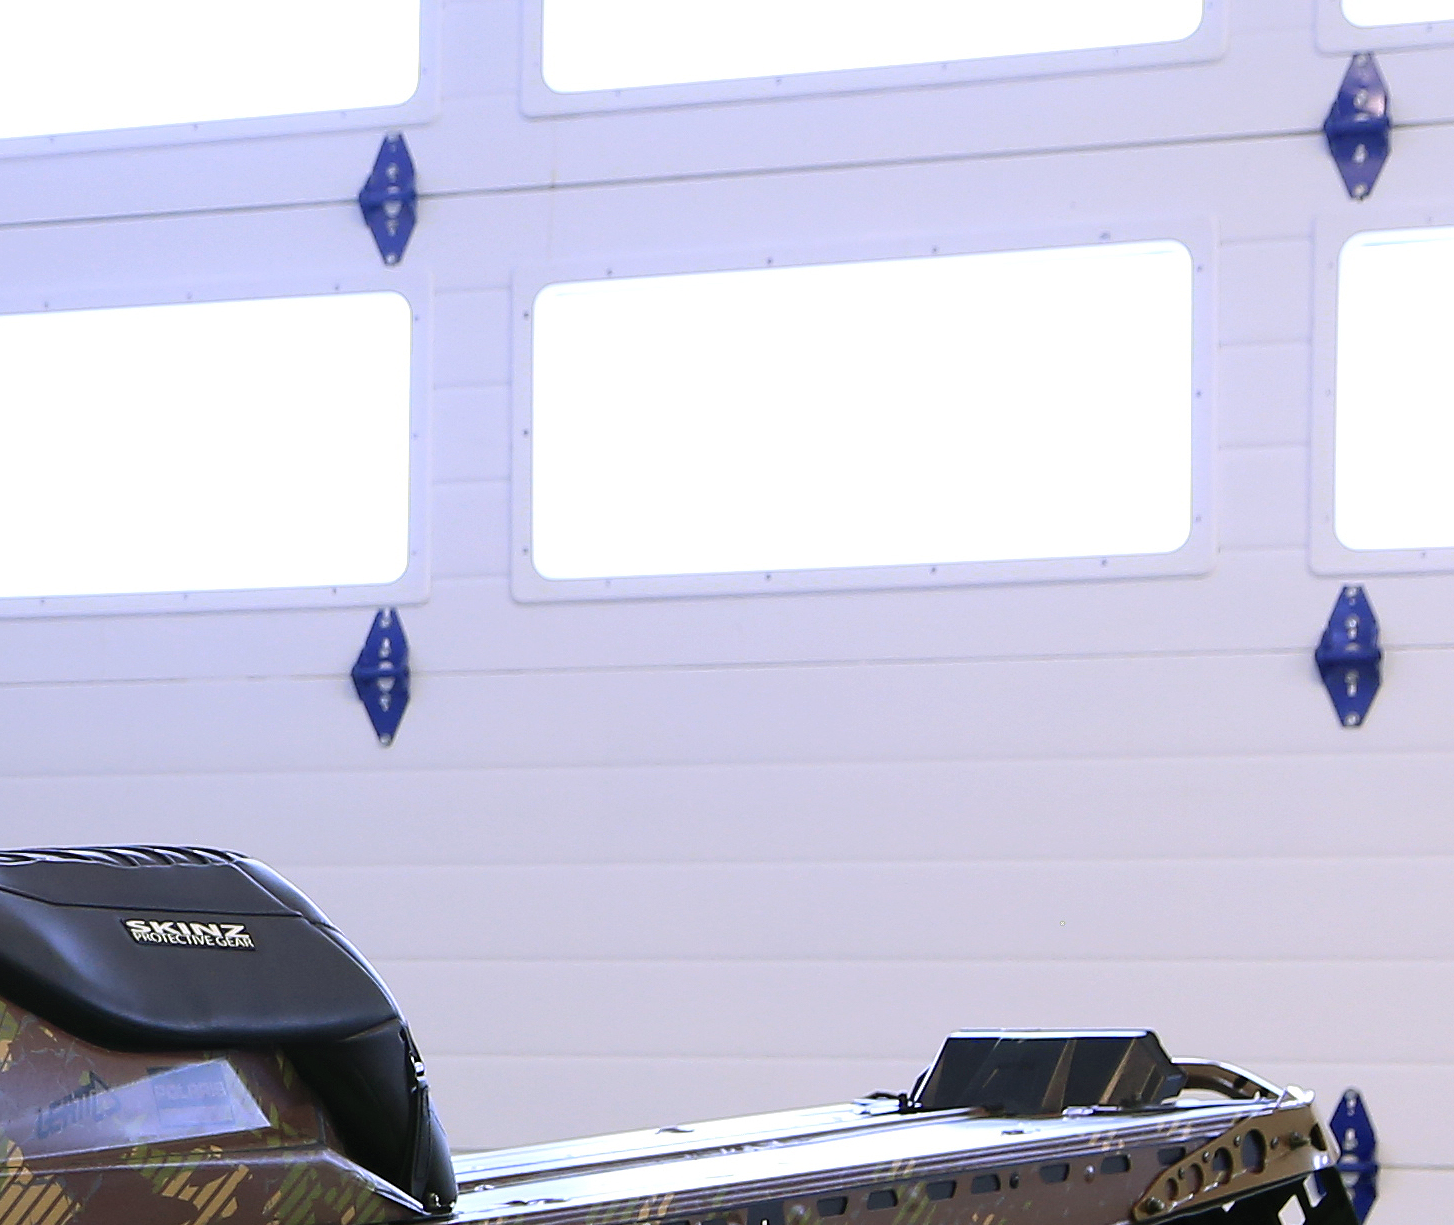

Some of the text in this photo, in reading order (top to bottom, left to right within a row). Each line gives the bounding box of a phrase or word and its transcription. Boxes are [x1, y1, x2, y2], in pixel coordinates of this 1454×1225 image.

[125, 919, 250, 939] SKINZ
[131, 930, 255, 948] PROTECTIVE GEAR
